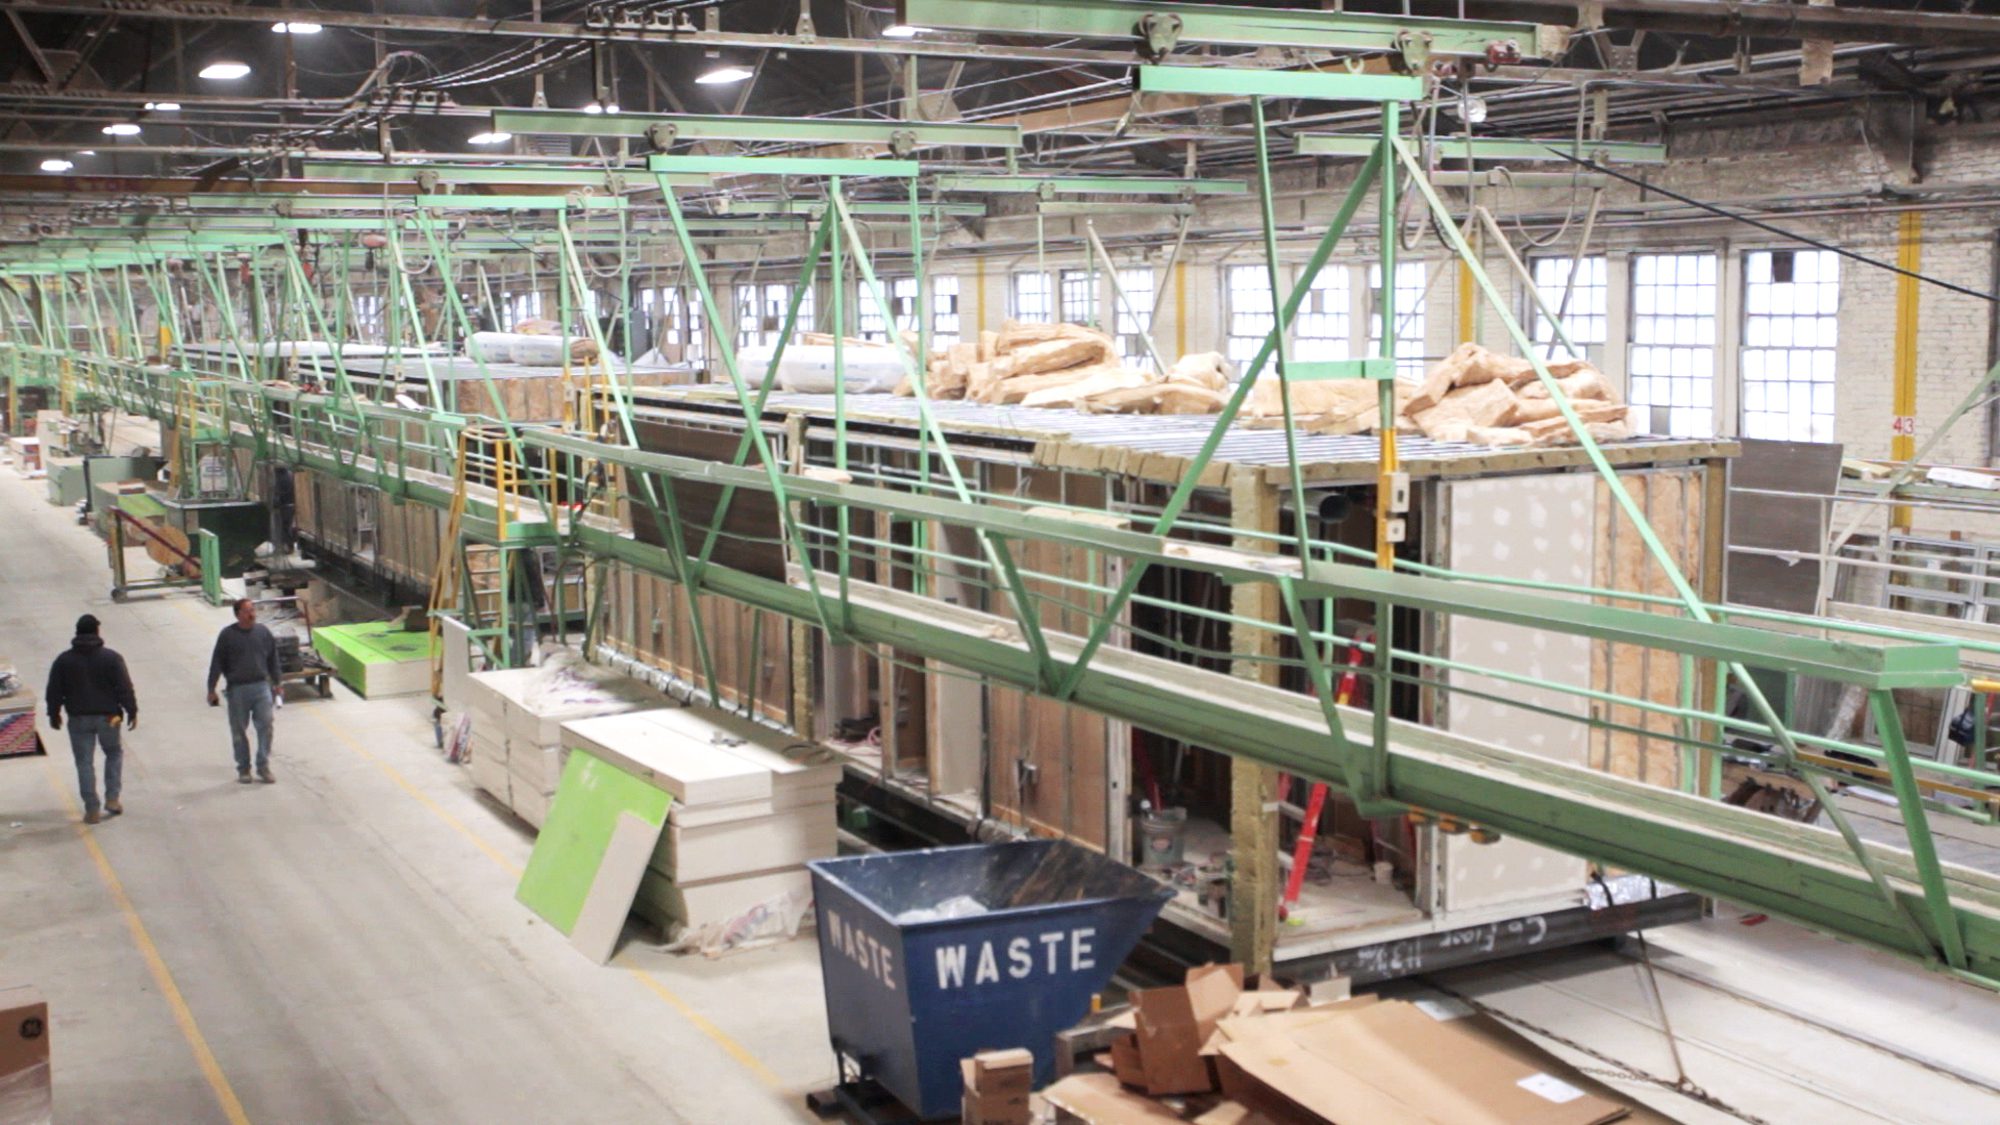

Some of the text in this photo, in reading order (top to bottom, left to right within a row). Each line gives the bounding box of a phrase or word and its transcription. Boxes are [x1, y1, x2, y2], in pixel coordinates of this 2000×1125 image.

[1893, 416, 1914, 434] 43
[828, 910, 896, 990] WASTE
[935, 927, 1096, 990] WASTE
